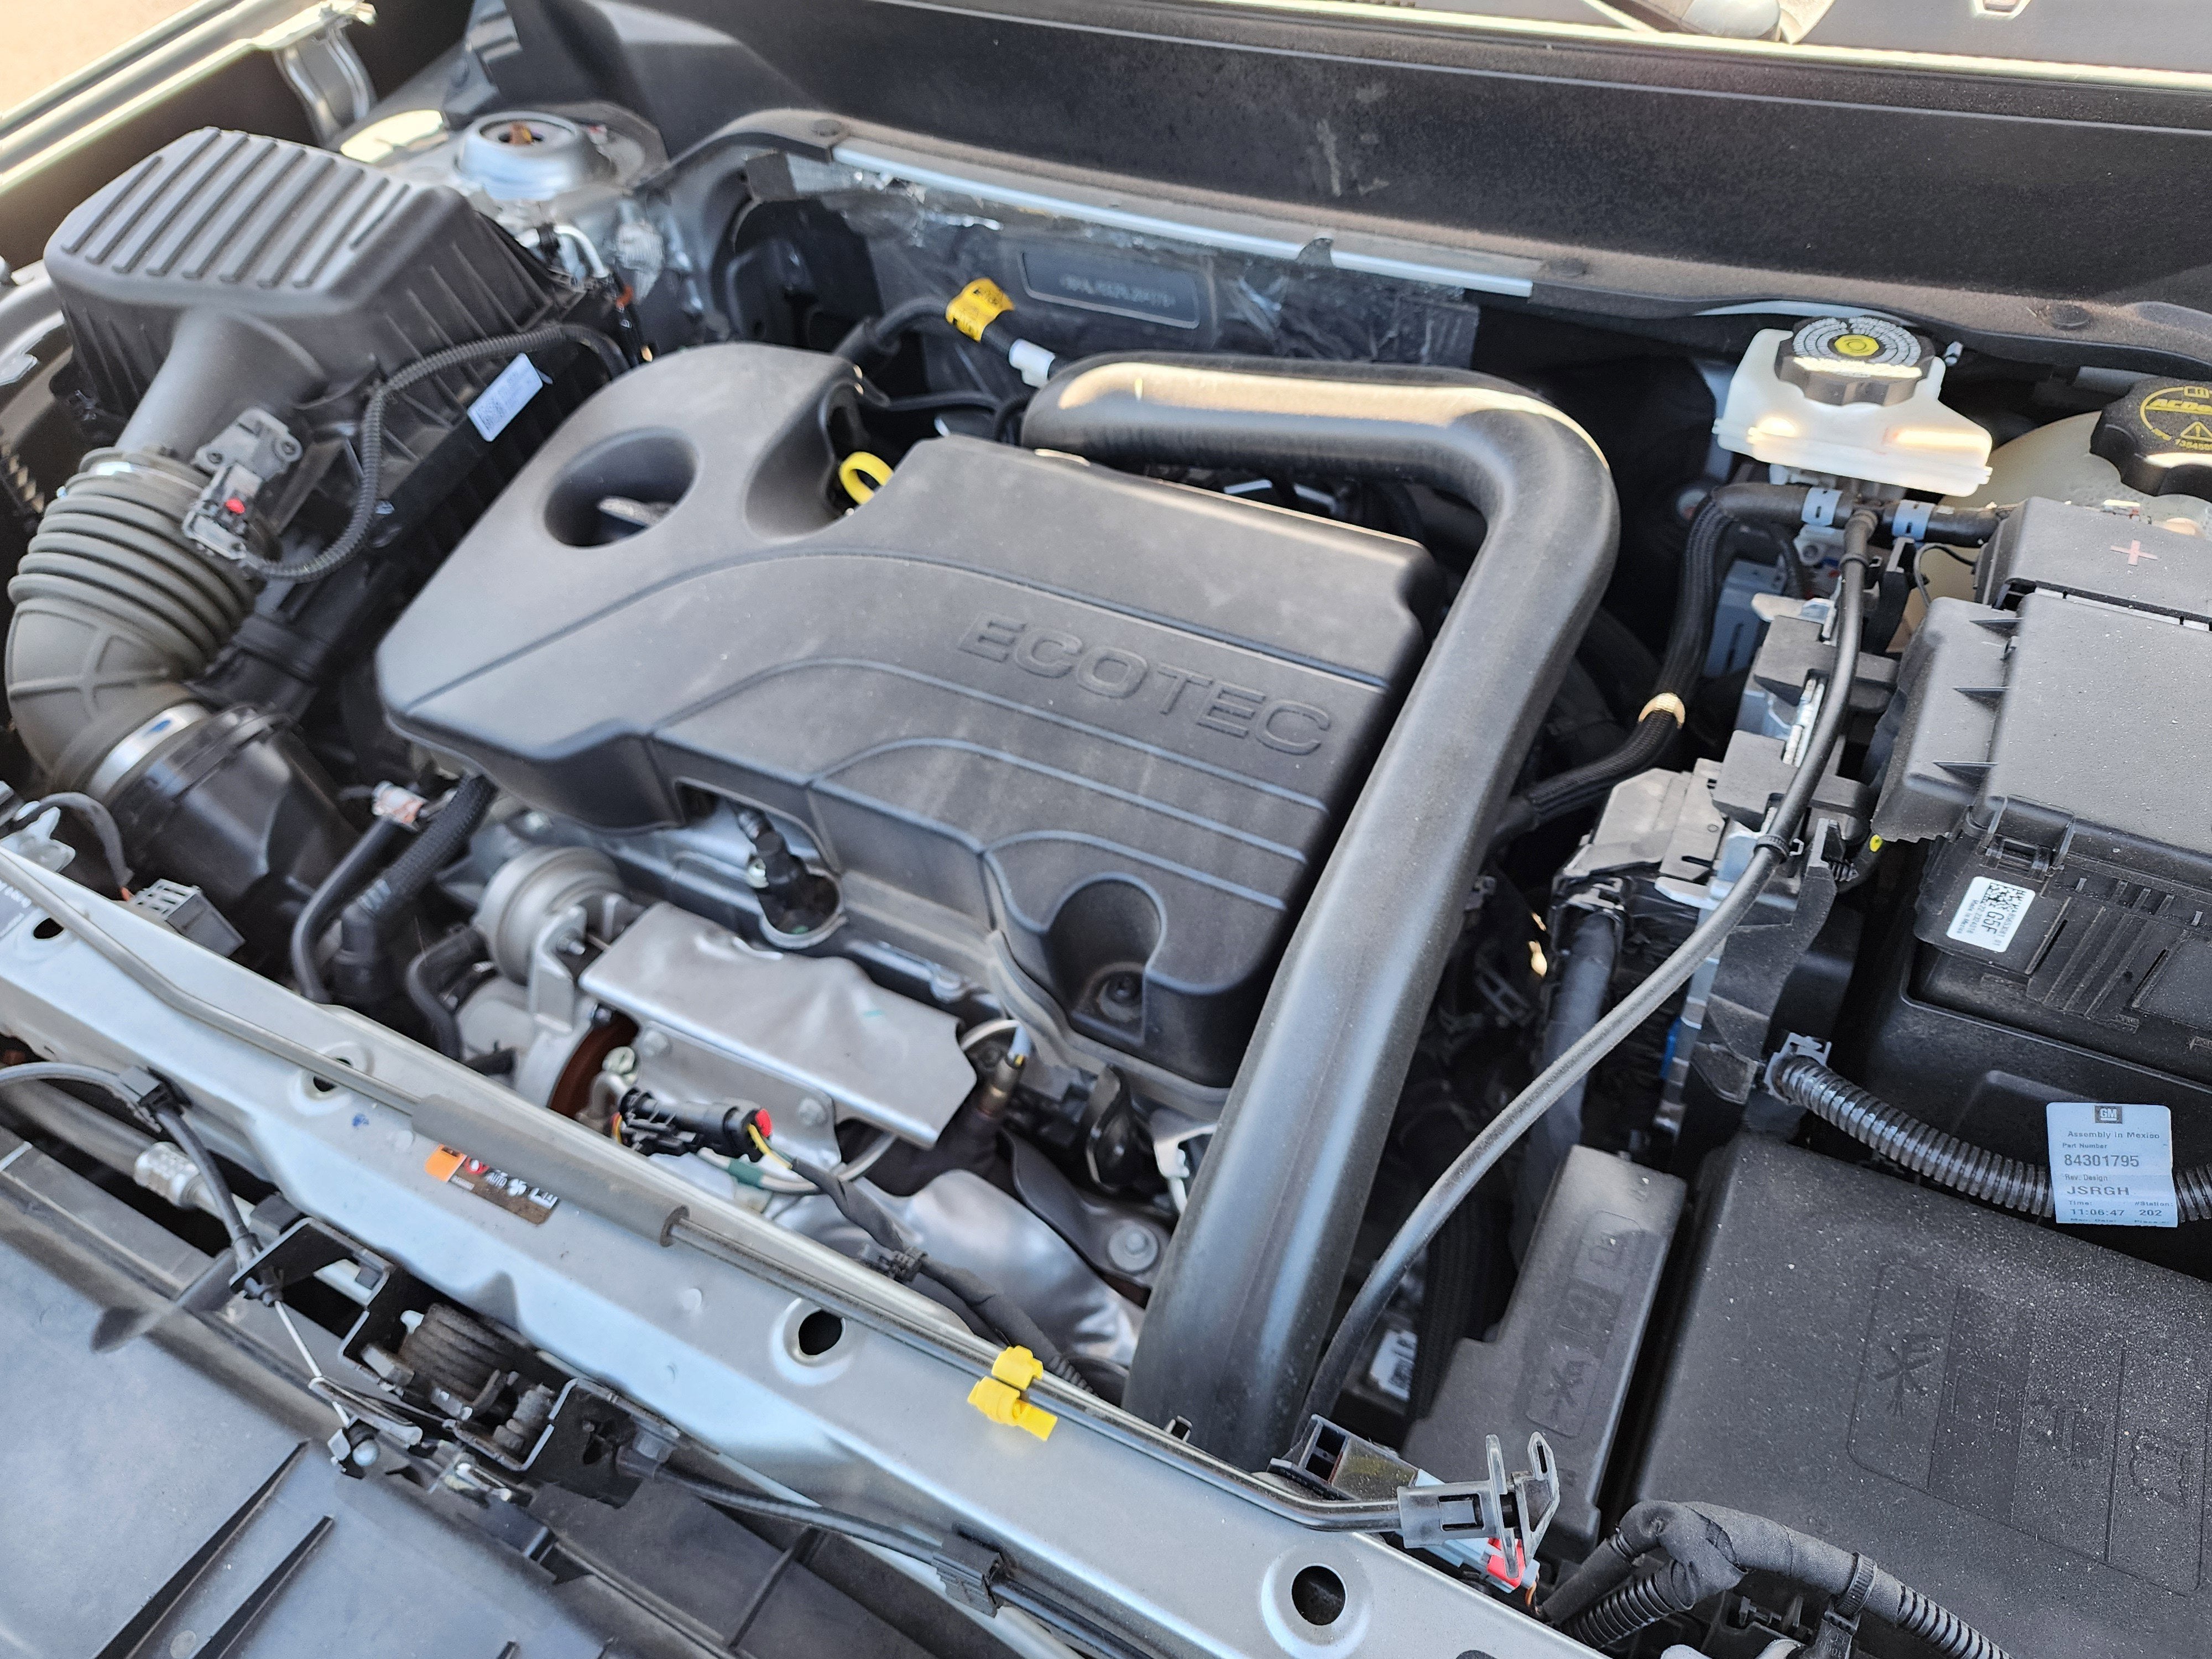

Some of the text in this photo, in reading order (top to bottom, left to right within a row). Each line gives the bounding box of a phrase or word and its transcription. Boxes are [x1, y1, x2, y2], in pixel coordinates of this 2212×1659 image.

[958, 612, 1331, 756] ECOTEC
[1981, 911, 2005, 934] G5F
[2100, 1108, 2117, 1118] GM
[2064, 1154, 2140, 1167] 84301795
[2067, 1186, 2130, 1196] JSRGH
